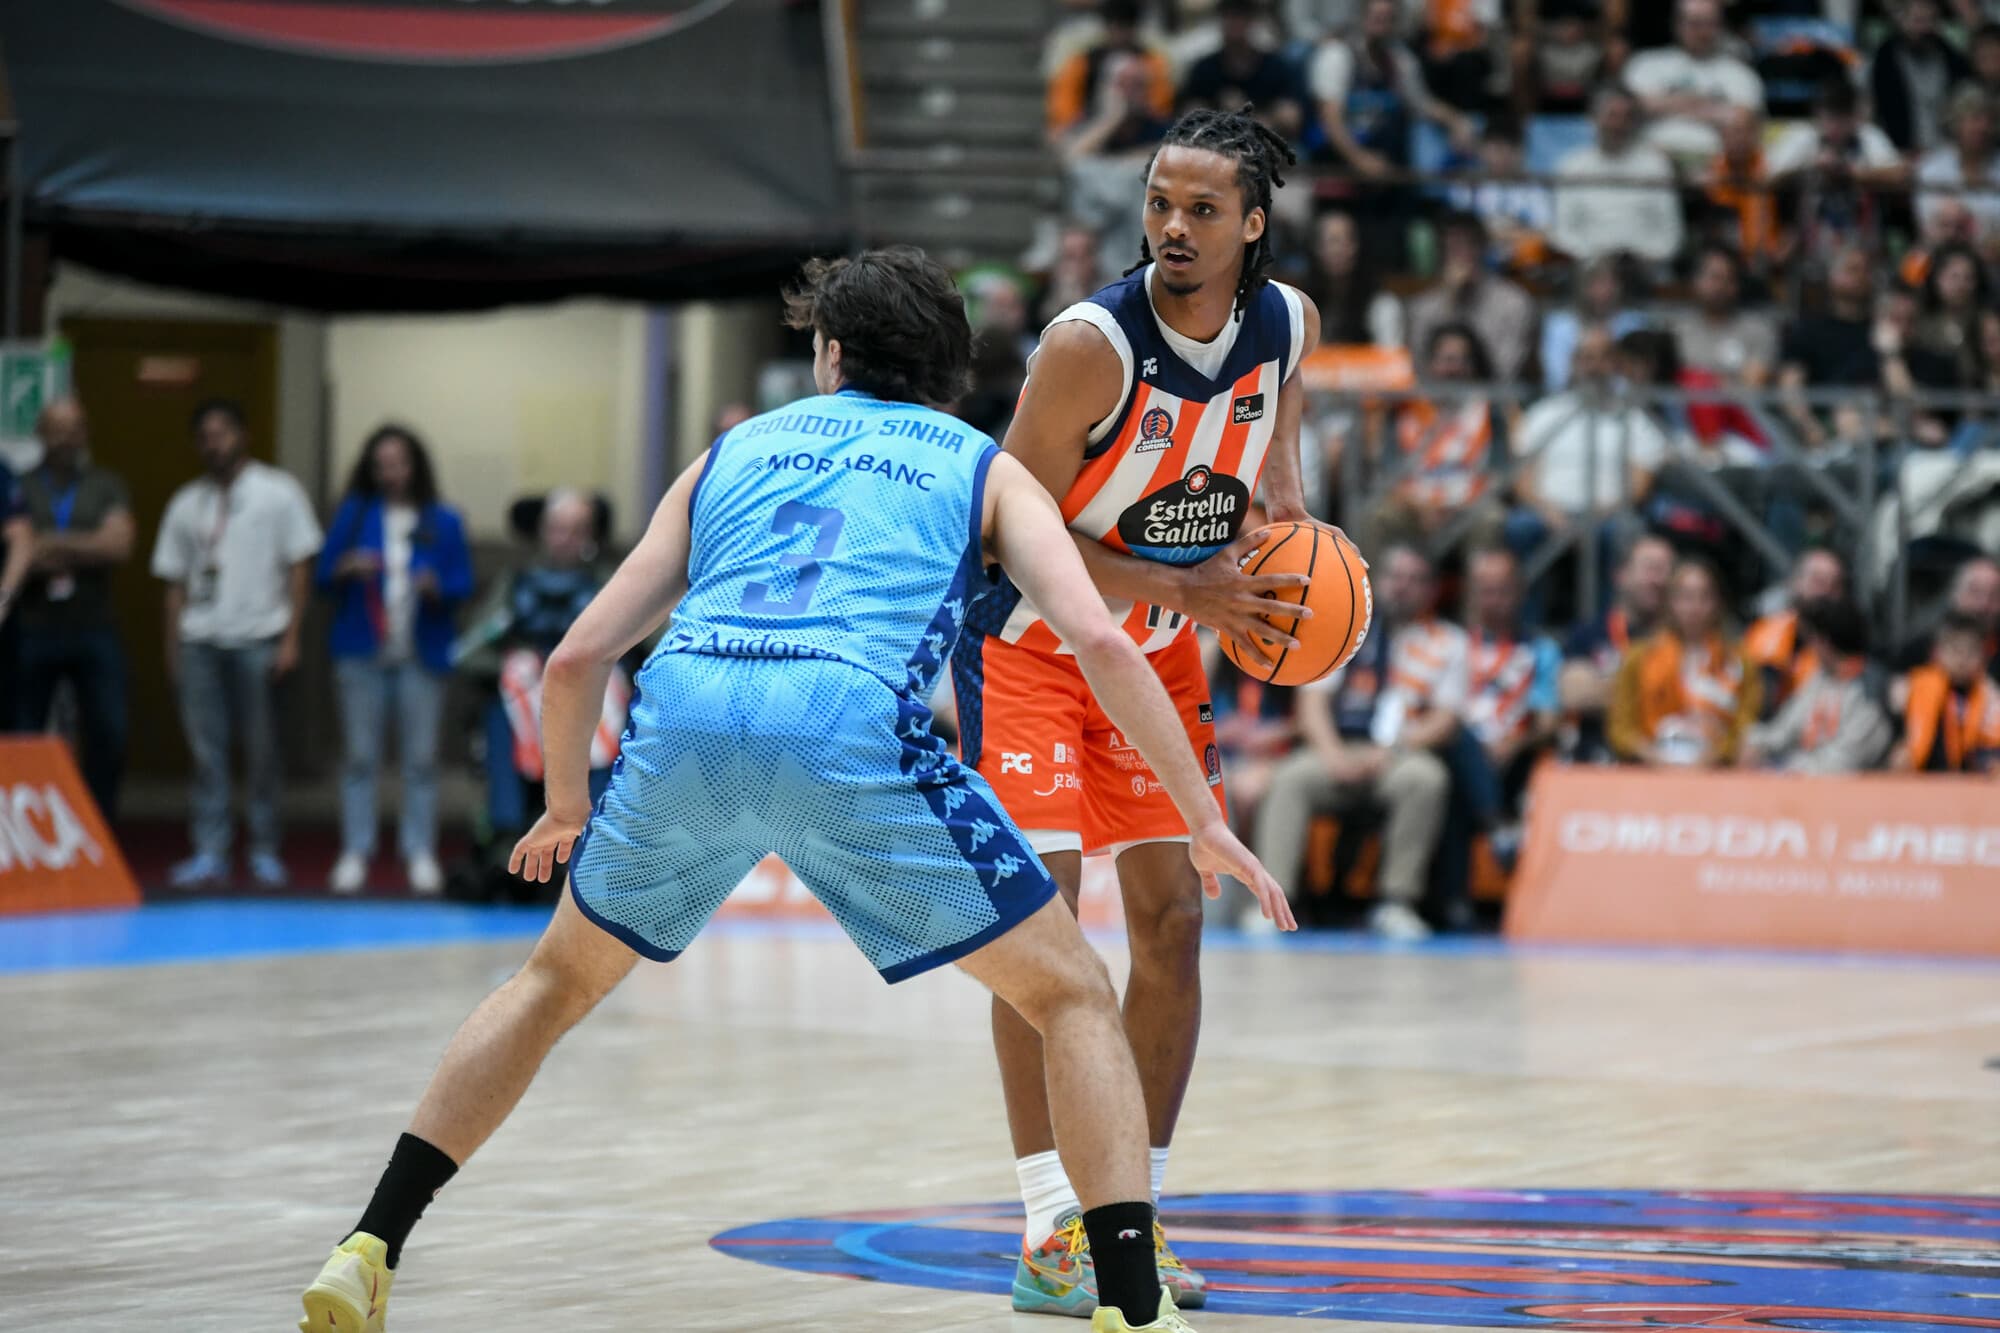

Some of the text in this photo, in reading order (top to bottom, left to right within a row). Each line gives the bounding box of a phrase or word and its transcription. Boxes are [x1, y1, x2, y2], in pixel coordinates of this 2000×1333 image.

[878, 419, 965, 454] SINHA
[1144, 492, 1235, 521] Estrella
[1144, 517, 1229, 543] Galicia
[740, 499, 846, 616] 3
[1001, 752, 1032, 774] PG
[1560, 812, 1808, 858] OMODA
